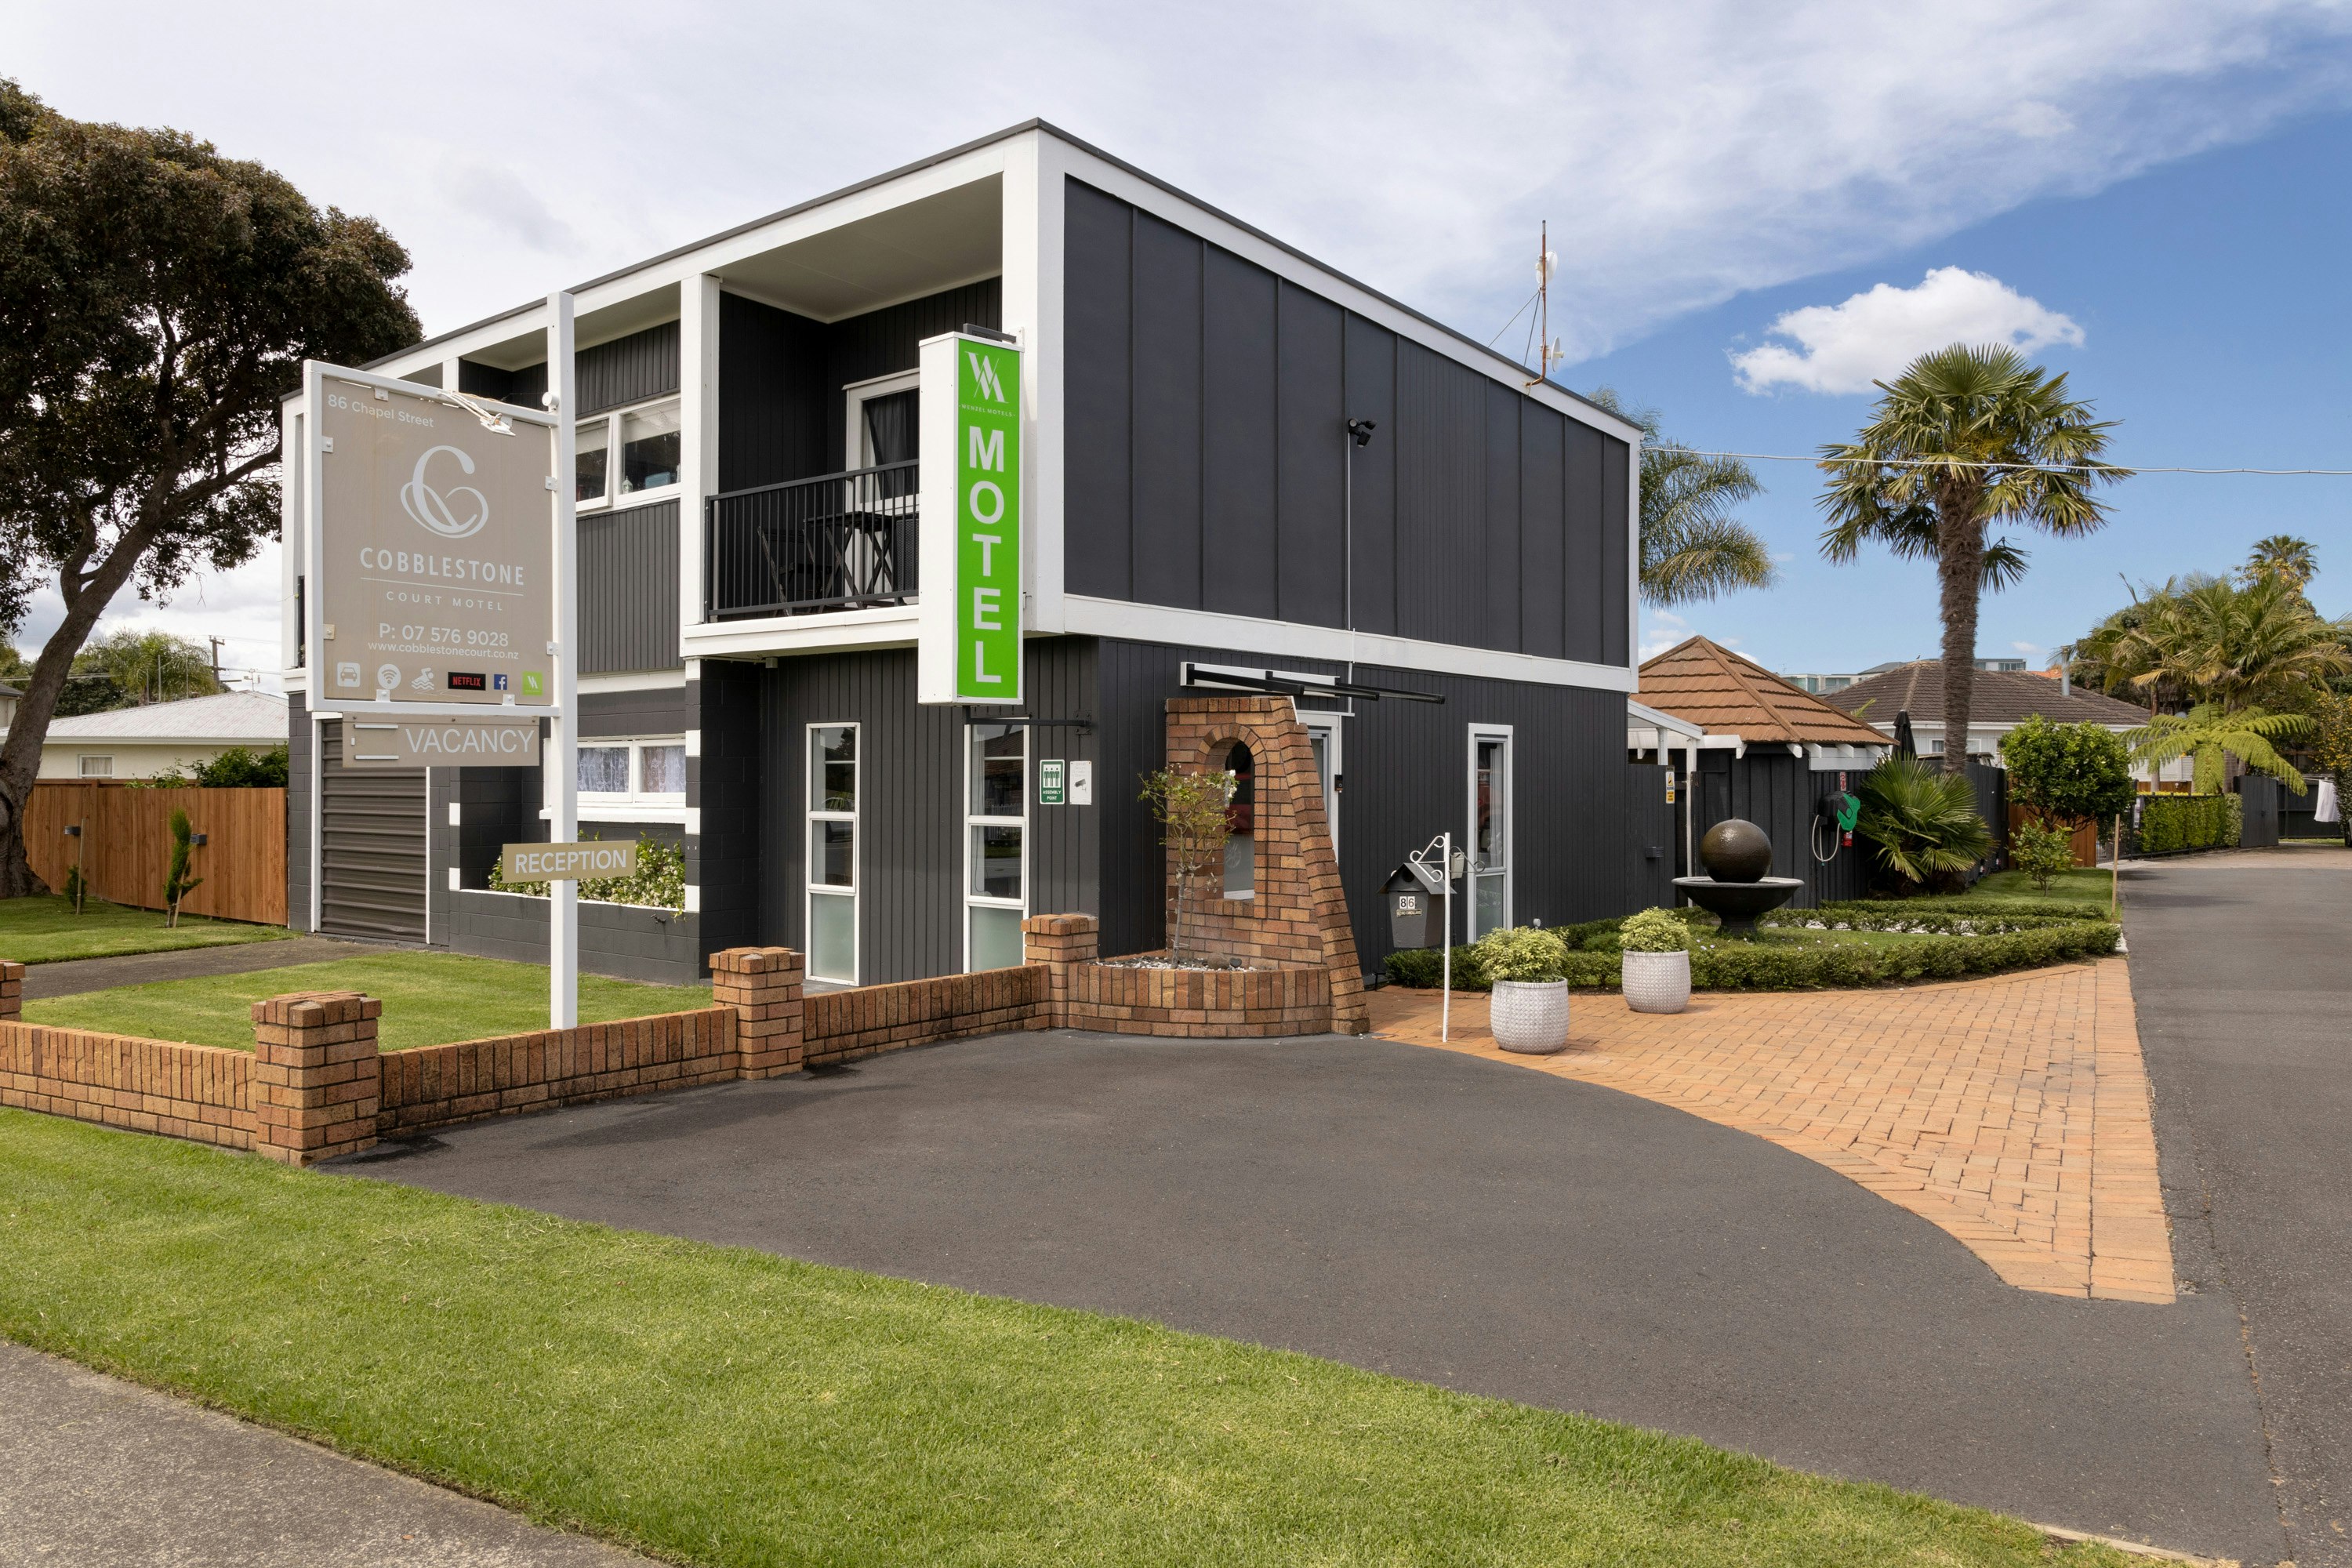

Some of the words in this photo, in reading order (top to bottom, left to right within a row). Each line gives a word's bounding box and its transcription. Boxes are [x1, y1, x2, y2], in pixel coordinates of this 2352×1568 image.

[328, 394, 347, 409] 86
[351, 401, 394, 419] Chapel
[398, 411, 434, 428] Street
[961, 404, 985, 412] WENZEL
[987, 408, 1013, 417] MOTELS
[360, 547, 524, 586] COBBLESTONE
[968, 425, 1006, 684] MOTEL
[386, 591, 442, 605] COURT
[452, 597, 503, 611] MOTEL
[379, 622, 395, 639] P:
[401, 625, 425, 641] 07
[430, 627, 461, 644] 576
[466, 630, 509, 647] 9028
[368, 642, 519, 659] www.cobblestonecourt.co.nz
[452, 677, 481, 687] NETFLIX
[405, 728, 535, 753] VACANCY
[515, 849, 626, 874] RECEPTION
[1400, 898, 1414, 908] 86
